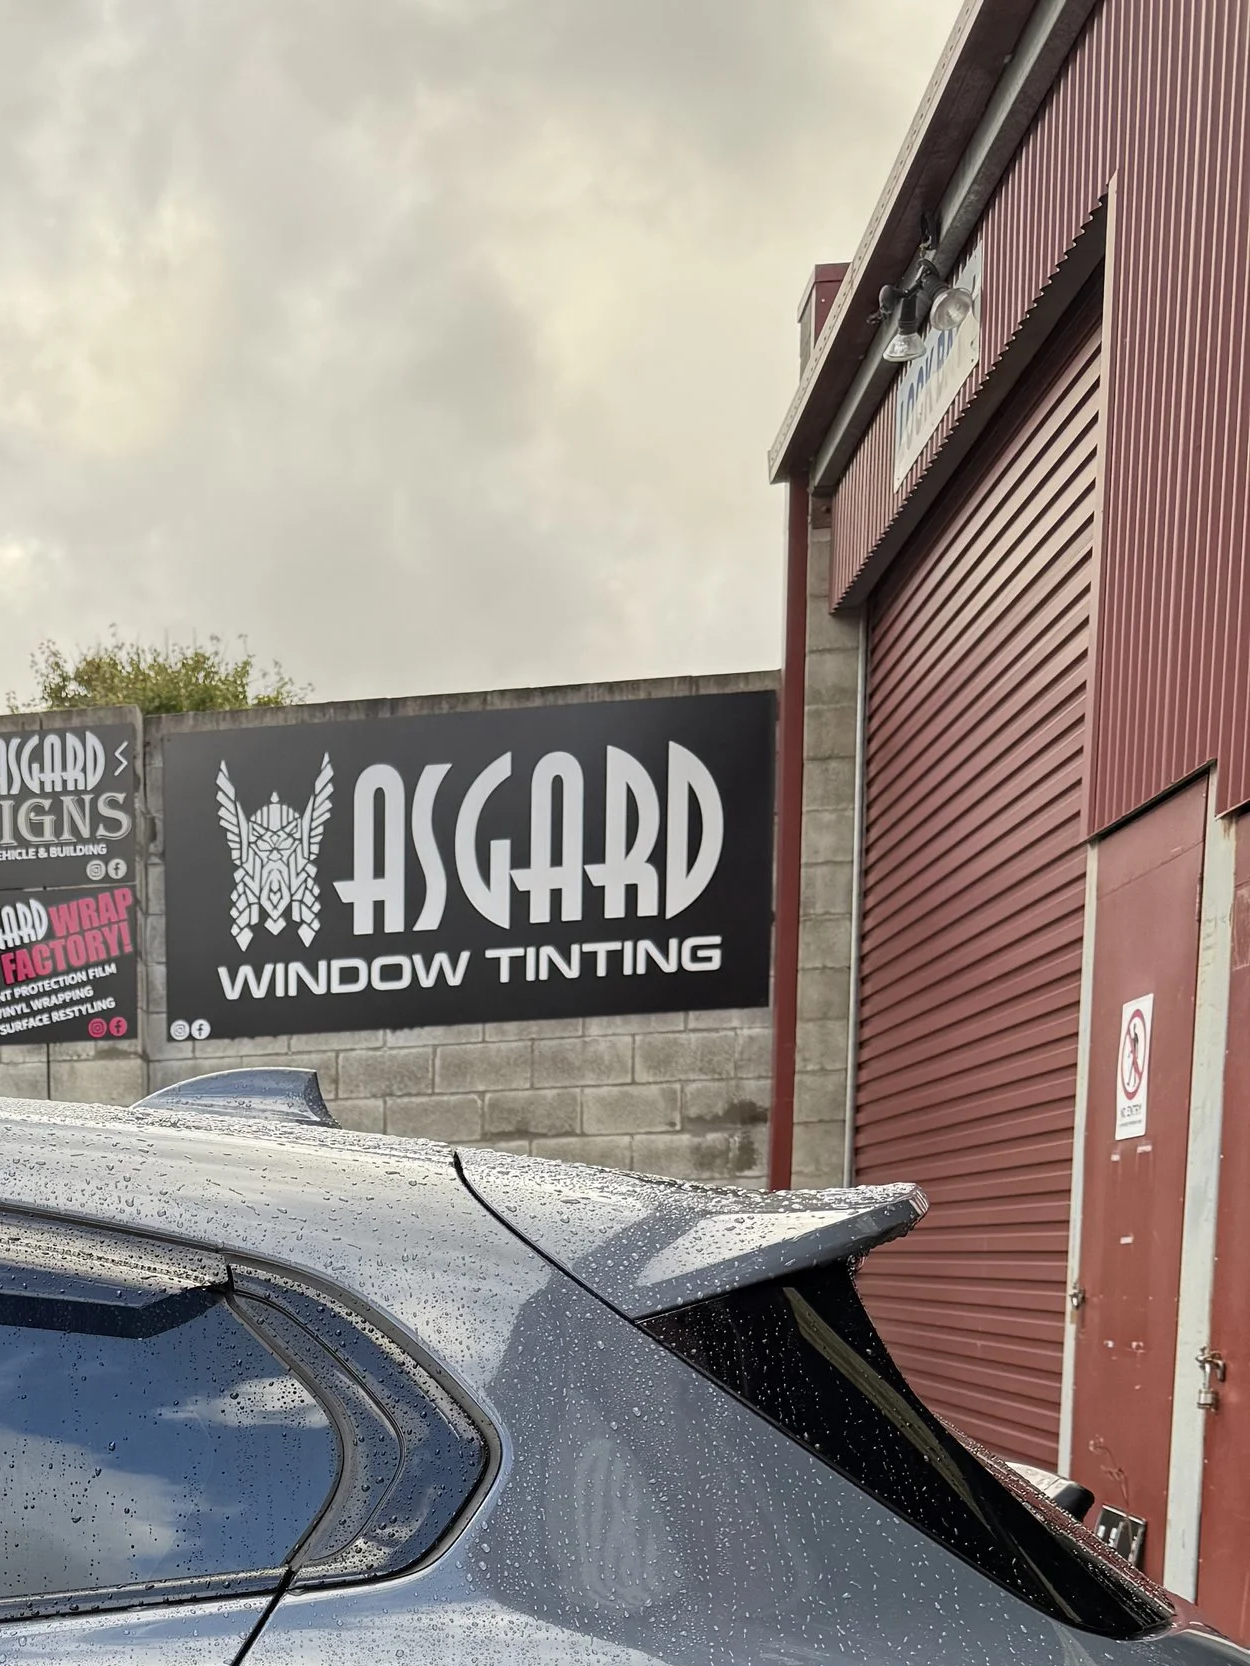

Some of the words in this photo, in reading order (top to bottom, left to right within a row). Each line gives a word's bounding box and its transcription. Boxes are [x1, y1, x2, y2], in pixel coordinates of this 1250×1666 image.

[38, 847, 48, 858] &
[49, 844, 107, 858] BUILDING
[333, 740, 724, 935] ASGARD
[49, 887, 133, 938] WRAP
[0, 920, 133, 985] FACTORY!
[217, 950, 470, 1000] WINDOW
[485, 935, 722, 984] TINTING
[13, 972, 88, 999] PROTECTION
[88, 963, 117, 980] FILM
[30, 985, 94, 1013] WRAPPING
[50, 997, 116, 1023] RESTYLING
